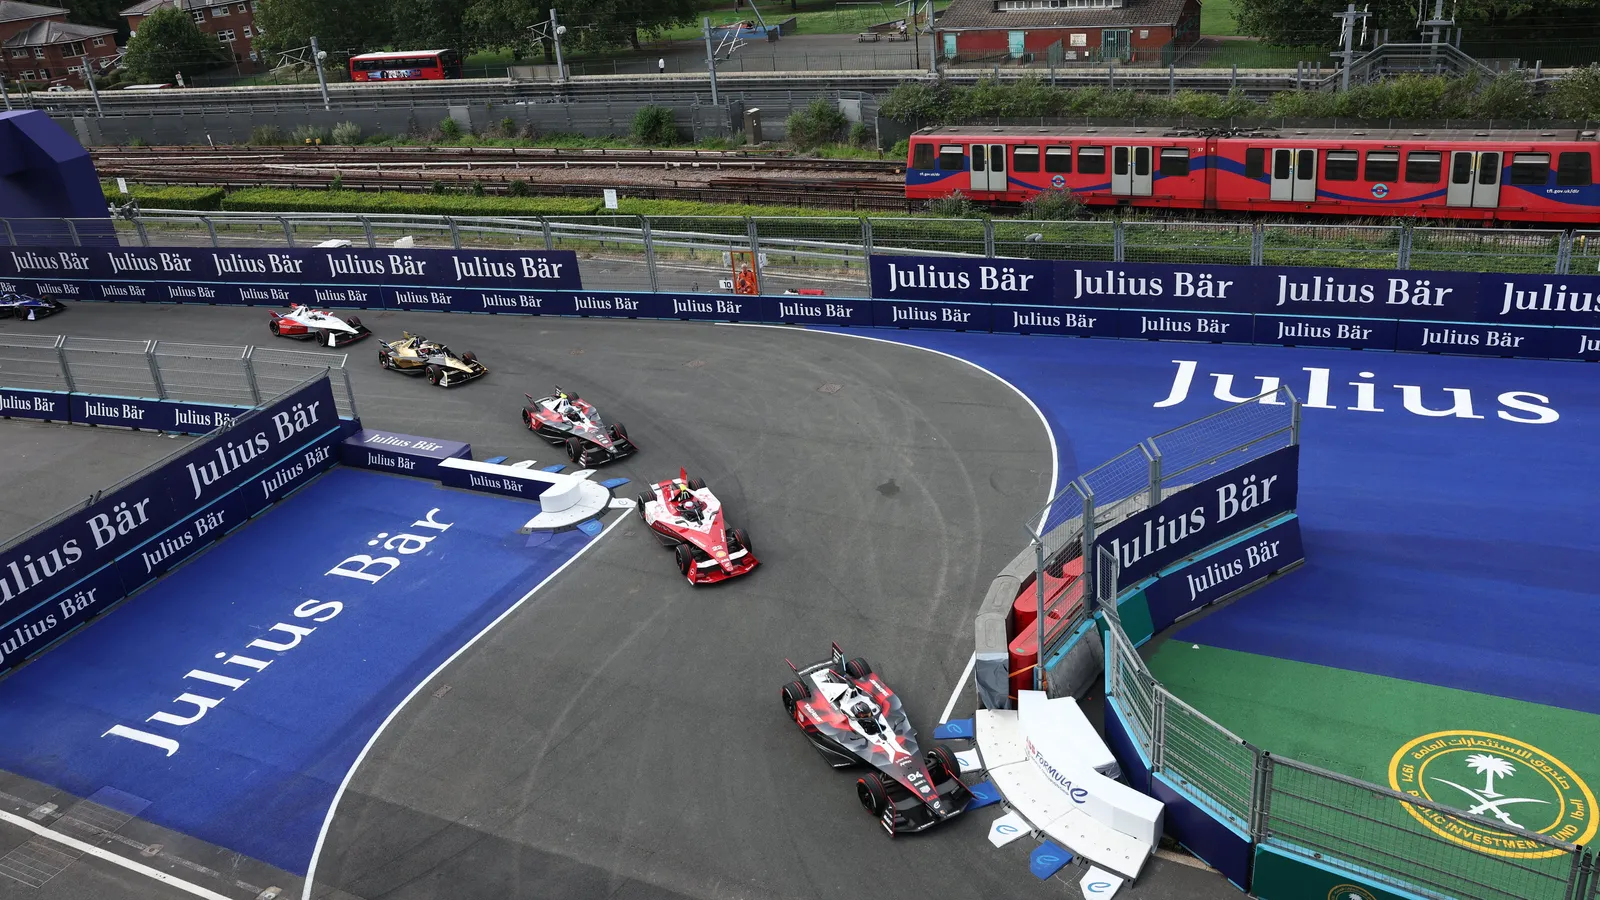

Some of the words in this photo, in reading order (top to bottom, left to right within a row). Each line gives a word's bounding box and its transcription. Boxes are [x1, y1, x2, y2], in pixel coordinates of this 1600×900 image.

[10, 251, 59, 273] Julius
[58, 251, 90, 270] Bär
[107, 252, 158, 274] Julius
[158, 252, 192, 272] Bär
[211, 253, 266, 277] Julius
[267, 253, 303, 274] Bär
[326, 253, 385, 278] Julius
[387, 254, 427, 276] Bär
[452, 255, 516, 281] Julius
[519, 257, 563, 279] Bär
[0, 281, 16, 292] Bär
[887, 263, 970, 292] Julius
[978, 266, 1034, 292] Bär
[1073, 269, 1163, 299] Julius
[1173, 271, 1234, 299] Bär
[36, 283, 63, 295] Julius
[62, 283, 80, 294] Bär
[100, 284, 127, 297] Julius
[128, 285, 146, 296] Bär
[167, 285, 196, 299] Julius
[196, 286, 216, 298] Bär
[239, 287, 268, 301] Julius
[269, 288, 290, 300] Bär
[314, 289, 345, 303] Julius
[347, 289, 368, 302] Bär
[395, 290, 429, 305] Julius
[430, 292, 452, 304] Bär
[1276, 274, 1375, 306] Julius
[1385, 278, 1454, 307] Bär
[481, 293, 517, 308] Julius
[519, 295, 543, 308] Bär
[574, 296, 612, 311] Julius
[614, 297, 639, 310] Bär
[672, 298, 713, 314] Julius
[716, 300, 742, 314] Bär
[779, 302, 822, 318] Julius
[825, 303, 854, 318] Bär
[892, 305, 937, 322] Julius
[941, 307, 971, 323] Bär
[1013, 311, 1061, 328] Julius
[1065, 313, 1097, 328] Bär
[1141, 316, 1192, 334] Julius
[1196, 318, 1230, 334] Bär
[1277, 321, 1331, 340] Julius
[1336, 324, 1373, 340] Bär
[1421, 327, 1480, 346] Julius
[1485, 331, 1525, 348] Bär
[1153, 359, 1560, 424] Julius
[34, 397, 55, 412] Bär
[85, 401, 120, 418] Julius
[122, 404, 145, 420] Bär
[175, 408, 211, 426] Julius
[185, 431, 270, 500] Julius
[271, 400, 320, 444] Bär
[365, 434, 412, 447] Julius
[411, 439, 444, 453] Bär
[367, 452, 395, 467] Julius
[397, 456, 416, 470] Bär
[261, 462, 304, 500] Julius
[304, 445, 330, 470] Bär
[469, 473, 501, 489] Julius
[503, 479, 523, 492] Bär
[1215, 474, 1278, 524] Bär
[141, 531, 194, 574] Julius
[194, 509, 225, 538] Bär
[0, 548, 83, 606] ulius
[85, 497, 150, 551] Bär
[1186, 557, 1244, 602] Julius
[1245, 540, 1280, 569] Bär
[58, 587, 97, 620] Bär
[100, 598, 344, 757] Julius
[323, 507, 454, 585] Bär
[1411, 739, 1447, 760] العامة
[907, 770, 923, 782] 94
[1035, 750, 1072, 791] FORMULA
[1402, 764, 1414, 782] 1971
[1530, 758, 1570, 790] صندوق
[1549, 824, 1579, 842] UND
